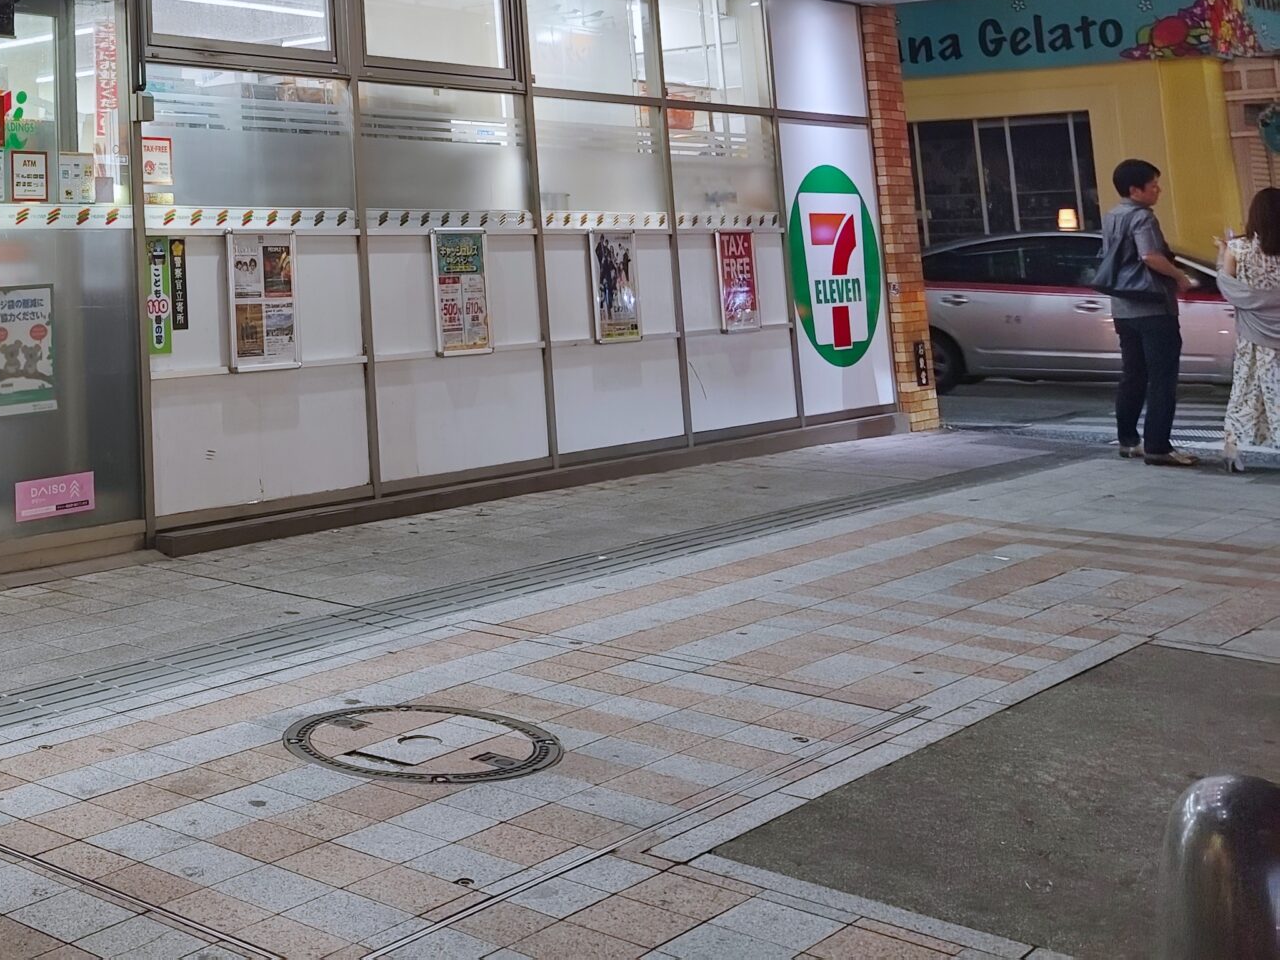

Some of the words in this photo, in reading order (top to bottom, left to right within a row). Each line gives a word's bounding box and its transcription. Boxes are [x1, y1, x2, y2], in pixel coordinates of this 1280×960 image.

[898, 33, 964, 65] na
[977, 14, 1124, 58] Gelato
[22, 159, 37, 168] ATM
[720, 235, 749, 256] TAX-
[723, 257, 751, 279] FREE
[30, 483, 67, 498] DAISO
